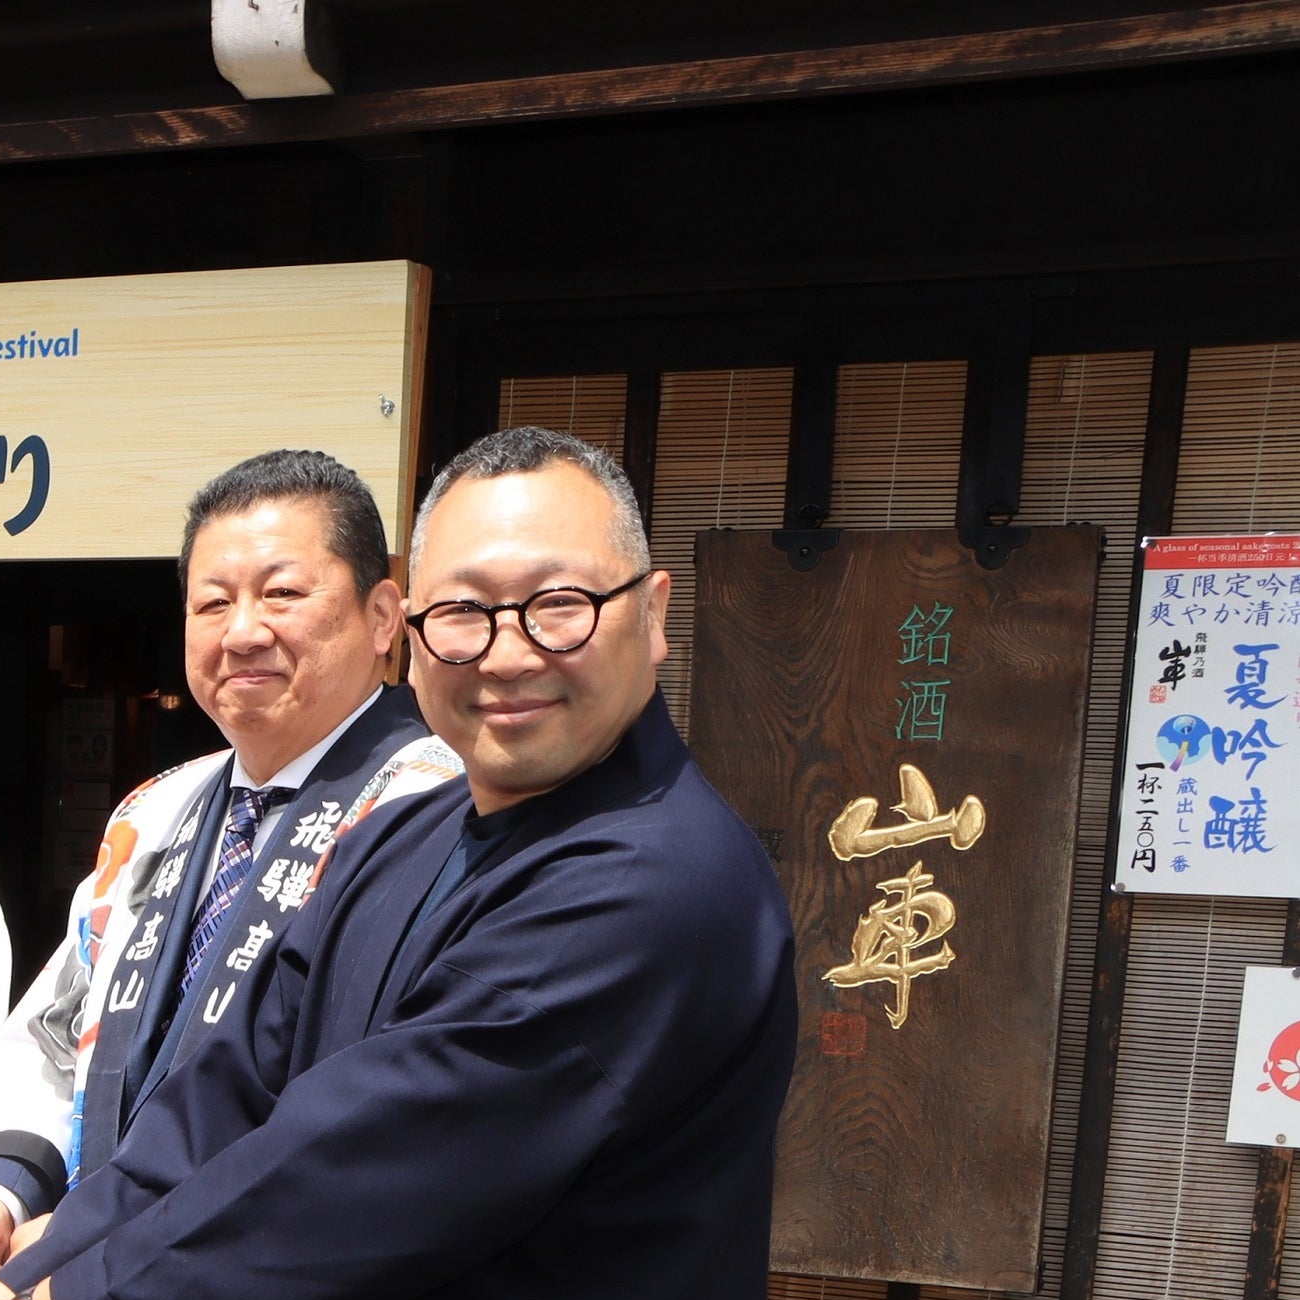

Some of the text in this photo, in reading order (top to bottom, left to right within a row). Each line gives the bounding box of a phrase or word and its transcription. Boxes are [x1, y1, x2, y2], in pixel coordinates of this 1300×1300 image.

[1162, 543, 1186, 554] glass
[1188, 542, 1199, 551] of
[1200, 542, 1240, 551] seasonal
[895, 601, 954, 742] 銘酒
[1203, 643, 1289, 854] 夏吟醸
[1169, 777, 1198, 873] 蔵出し一番
